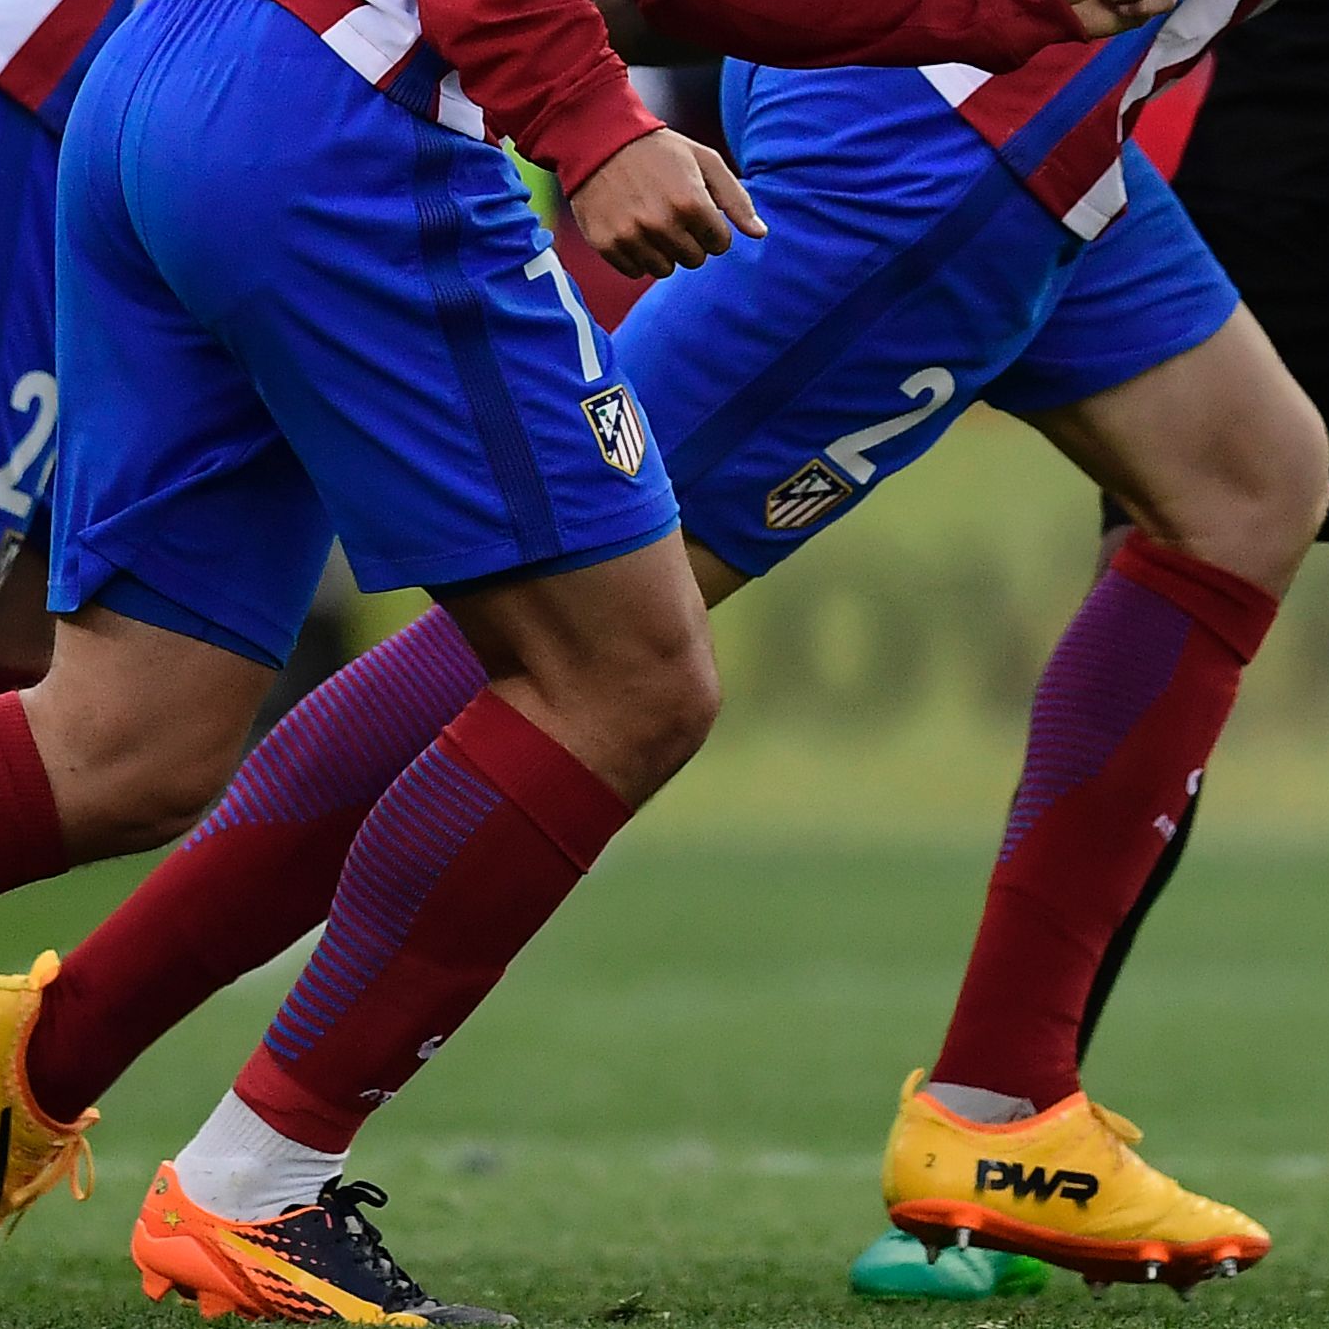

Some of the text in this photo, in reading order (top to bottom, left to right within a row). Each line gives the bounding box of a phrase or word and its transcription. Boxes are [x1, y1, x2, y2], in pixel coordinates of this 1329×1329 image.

[523, 247, 603, 383] 7
[823, 366, 956, 485] 2
[975, 1158, 1099, 1212] PWR
